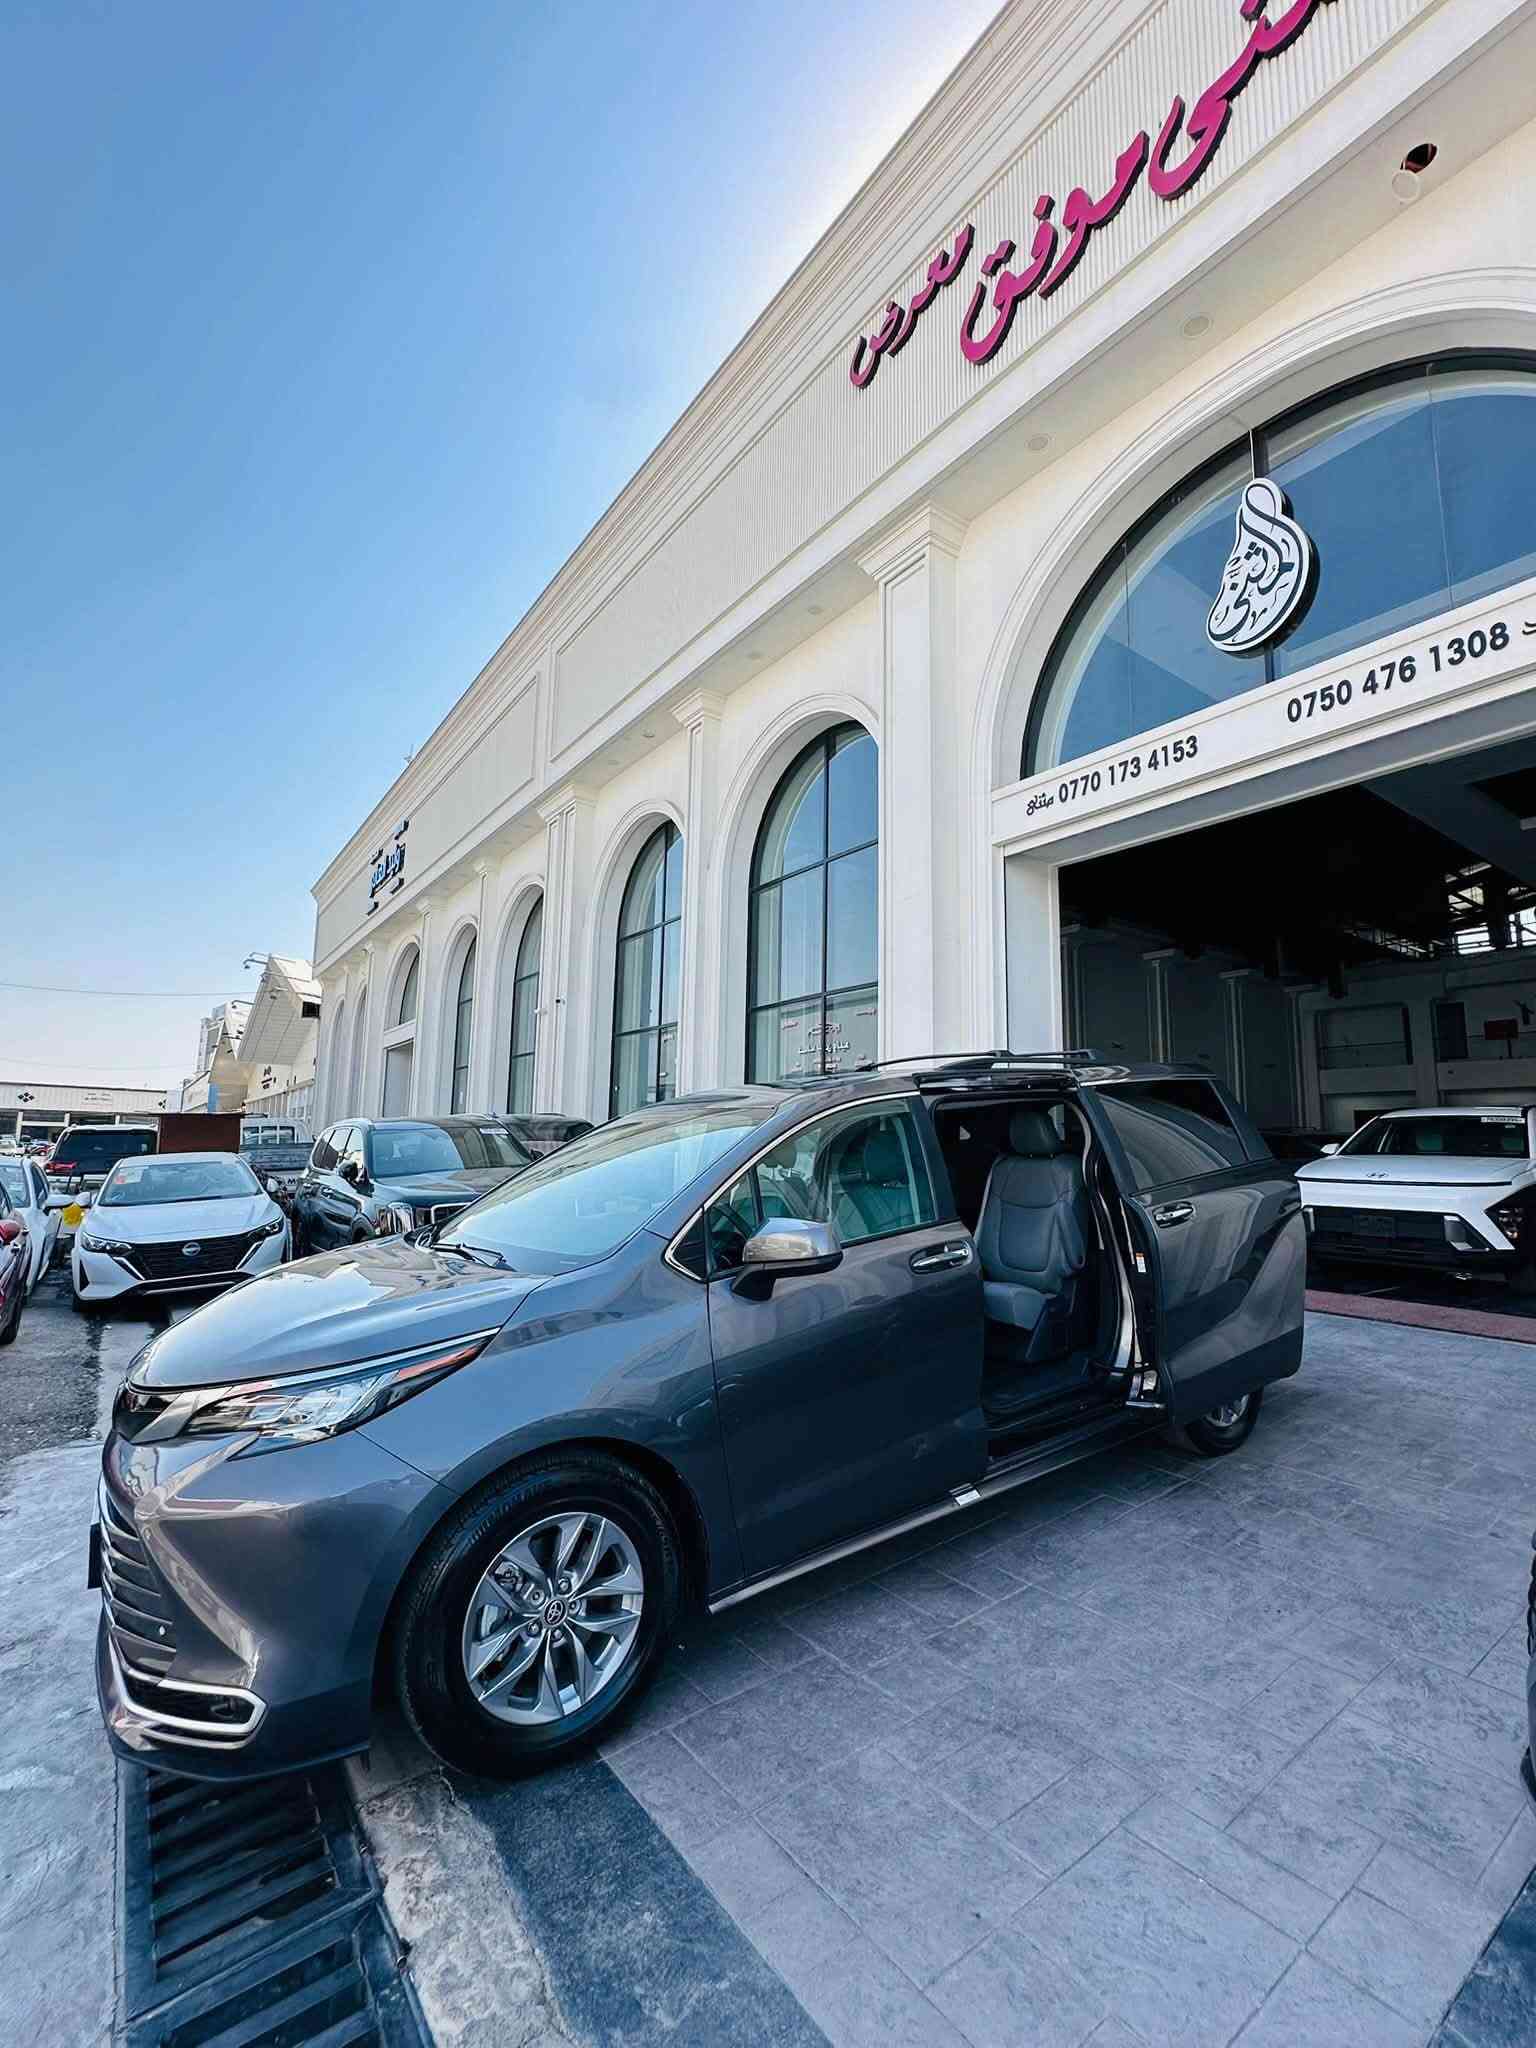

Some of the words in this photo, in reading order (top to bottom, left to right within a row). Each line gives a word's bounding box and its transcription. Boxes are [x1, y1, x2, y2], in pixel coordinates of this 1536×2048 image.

[1287, 680, 1352, 722] 0750
[1362, 655, 1417, 695] 476
[1429, 622, 1510, 673] 1308
[1059, 771, 1101, 803] 0770
[1108, 756, 1141, 786] 173
[1148, 735, 1198, 770] 4153
